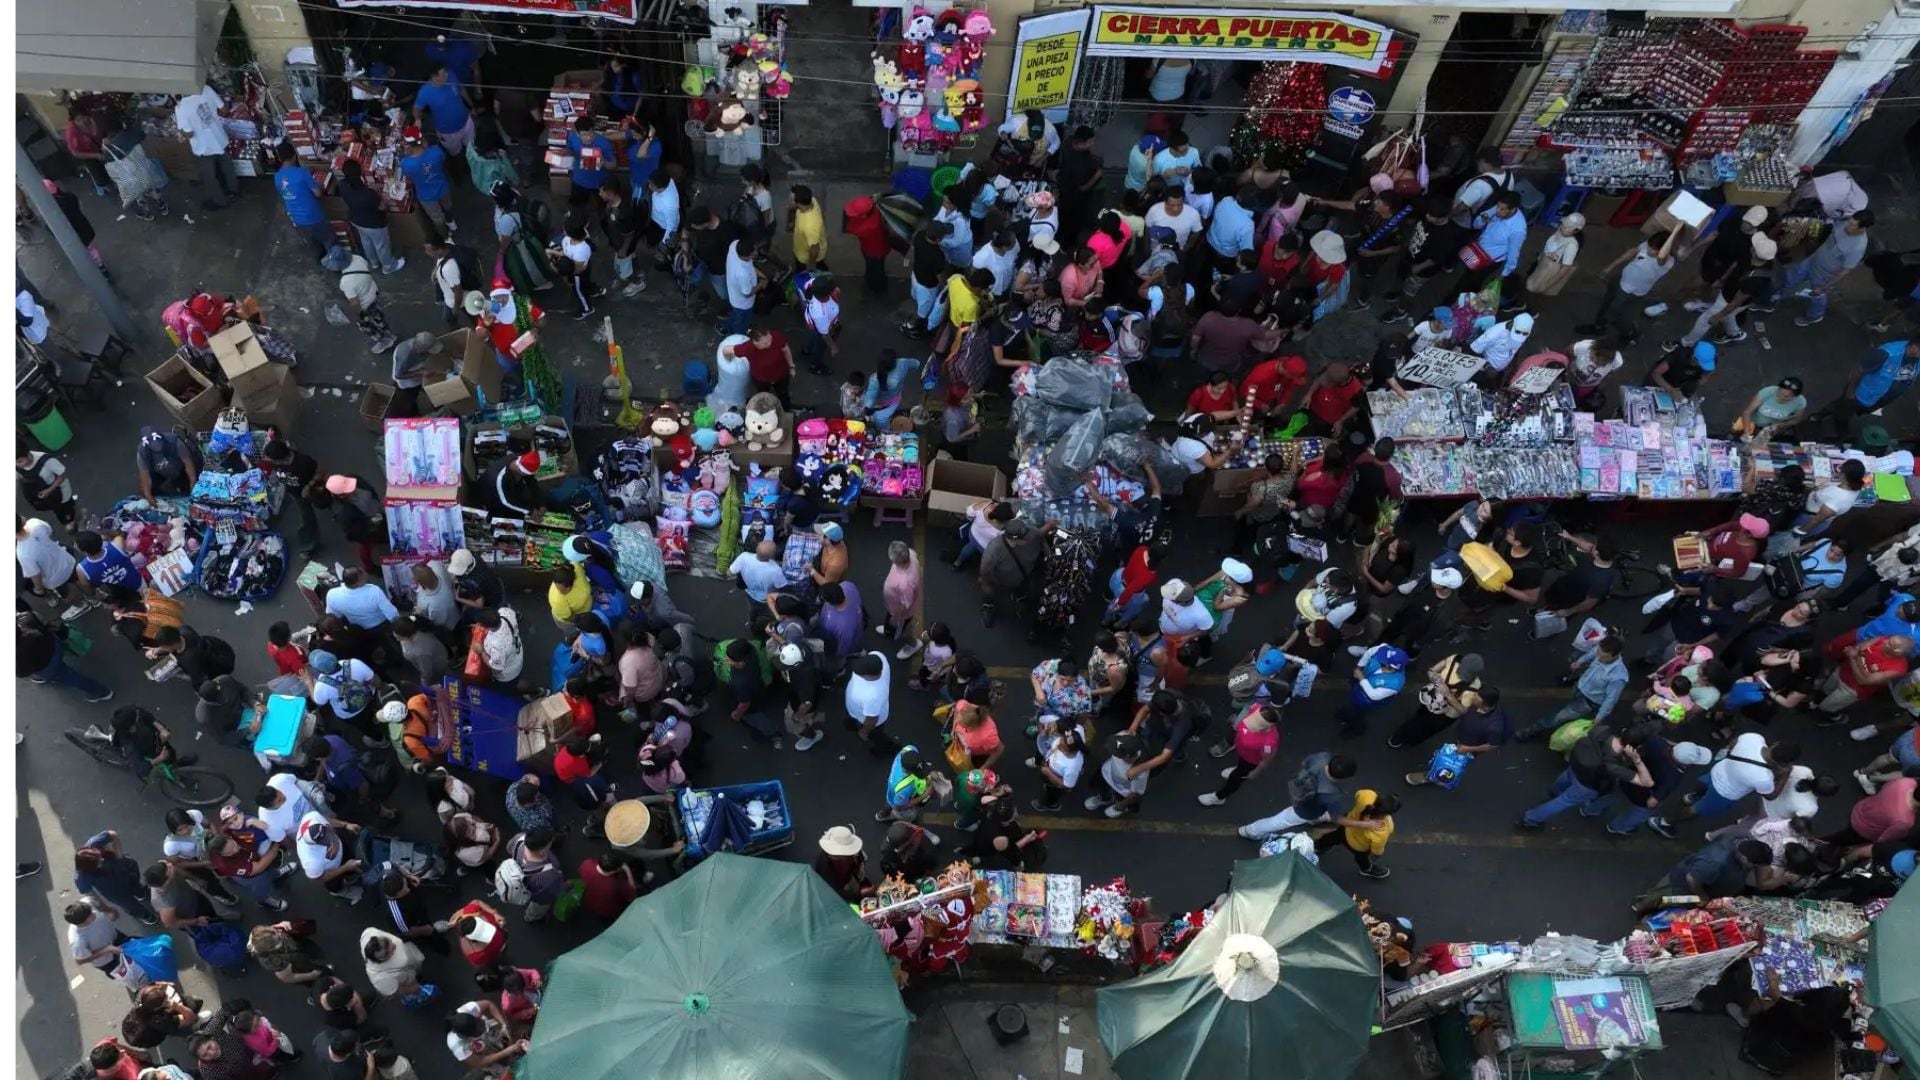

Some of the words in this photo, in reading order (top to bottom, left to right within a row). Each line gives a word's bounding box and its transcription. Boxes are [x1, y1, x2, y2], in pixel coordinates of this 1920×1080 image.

[1107, 15, 1220, 35] CIERRA
[1228, 18, 1371, 47] PUERTAS
[1036, 39, 1065, 53] DESDE
[1026, 57, 1045, 69] UNA
[1046, 52, 1069, 65] PIEZA
[1026, 73, 1031, 81] A
[1034, 67, 1065, 79] PRECIO
[1037, 81, 1049, 93] DE
[1017, 92, 1064, 109] MAYORISTA
